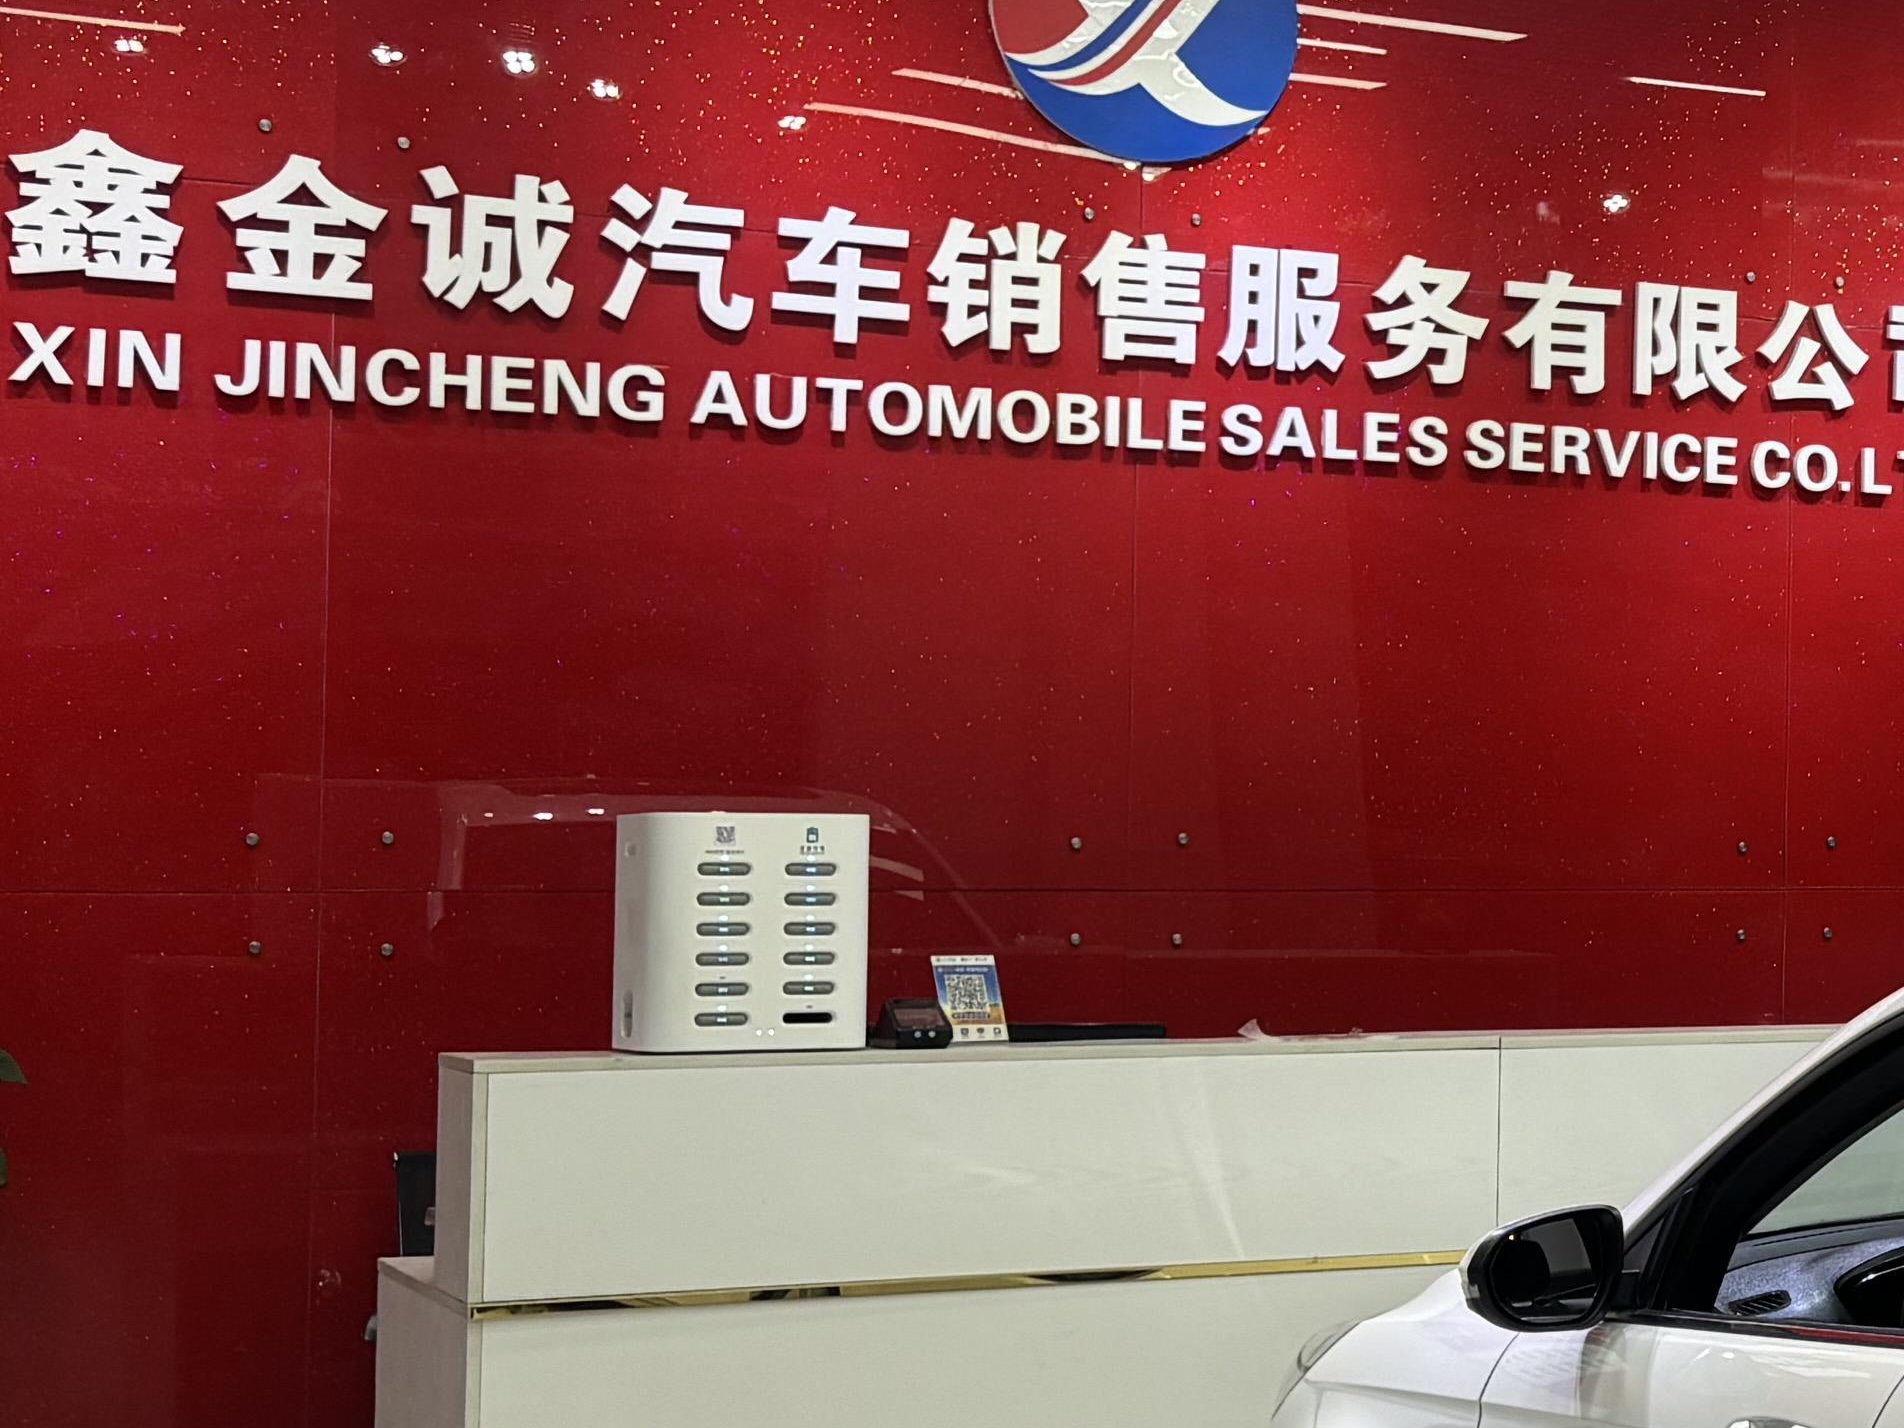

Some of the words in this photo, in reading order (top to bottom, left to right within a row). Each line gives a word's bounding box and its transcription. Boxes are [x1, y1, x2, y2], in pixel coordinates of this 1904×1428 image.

[12, 322, 183, 392] XIN
[213, 338, 666, 423] JINCHENG
[690, 370, 1206, 454] AUTOMOBILE
[1219, 401, 1449, 467] SALES
[1462, 420, 1738, 486] SERVICE
